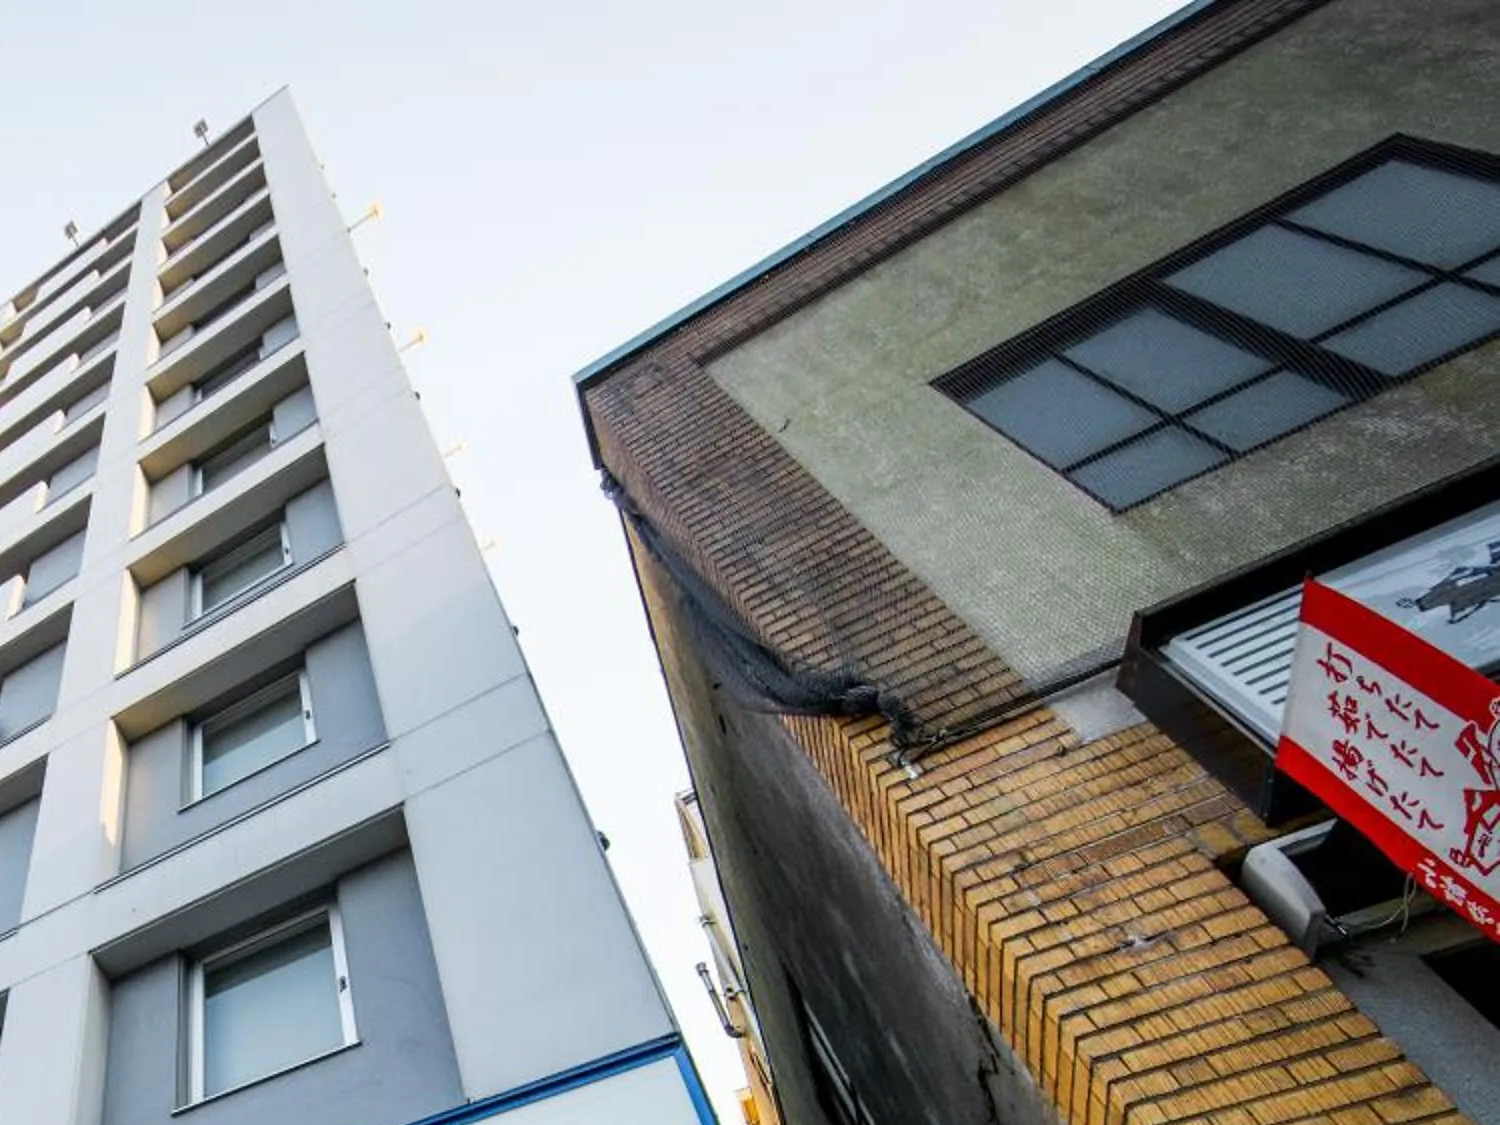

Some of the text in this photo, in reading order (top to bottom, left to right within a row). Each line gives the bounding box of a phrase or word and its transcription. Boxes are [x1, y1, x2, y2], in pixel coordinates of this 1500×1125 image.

[1316, 642, 1440, 730] 打ちたて
[1328, 690, 1444, 777] 茹でたて
[1331, 739, 1445, 830] 揚げたて
